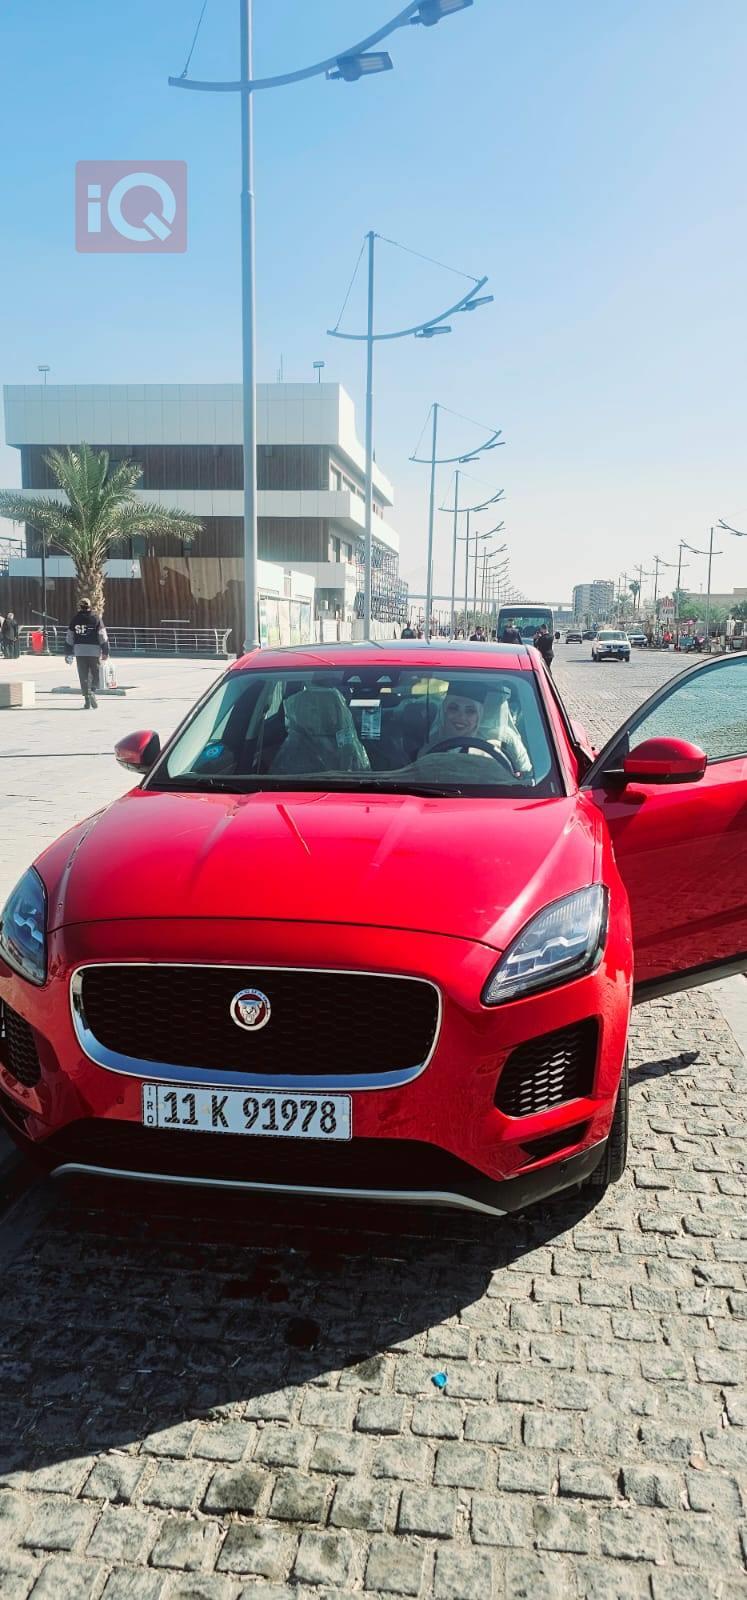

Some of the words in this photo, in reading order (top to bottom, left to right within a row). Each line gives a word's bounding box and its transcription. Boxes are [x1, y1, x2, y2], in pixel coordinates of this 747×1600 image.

[163, 1091, 199, 1126] 11
[211, 1094, 229, 1128] K
[242, 1097, 337, 1134] 91978
